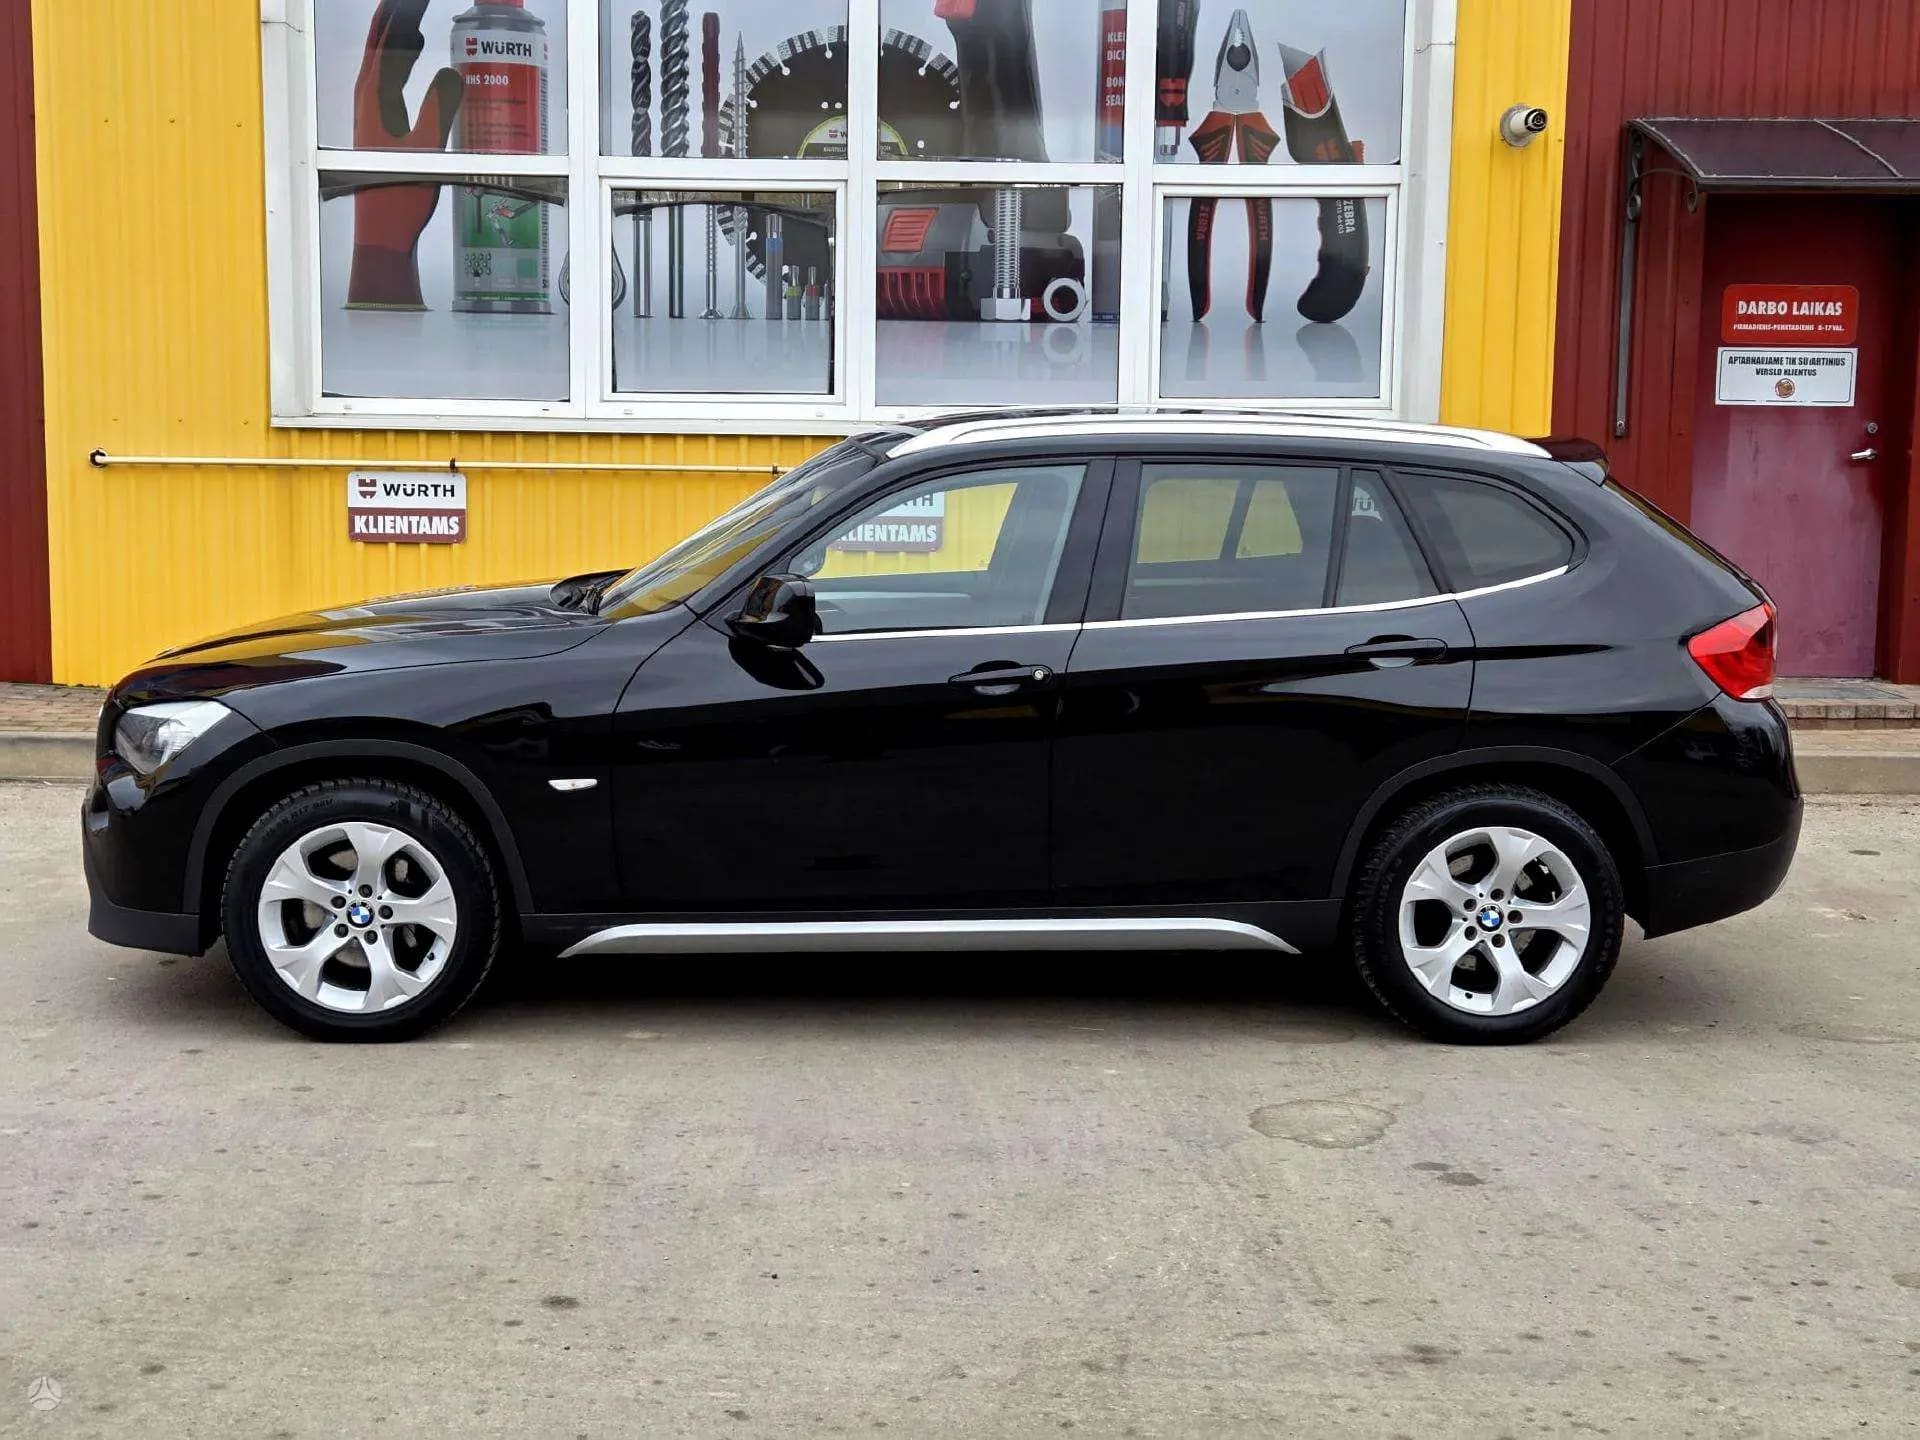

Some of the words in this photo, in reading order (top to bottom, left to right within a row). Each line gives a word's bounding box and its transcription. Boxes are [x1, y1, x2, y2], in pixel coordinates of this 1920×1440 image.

[481, 40, 532, 57] WÜRTH
[484, 74, 509, 86] 2000
[1343, 200, 1355, 233] ZEBRA
[1738, 301, 1788, 315] DARBO
[1792, 302, 1843, 316] LAIKAS
[1755, 368, 1782, 376] VERSLO
[383, 483, 455, 498] WÜRTH
[354, 515, 460, 535] KLIENTAMS
